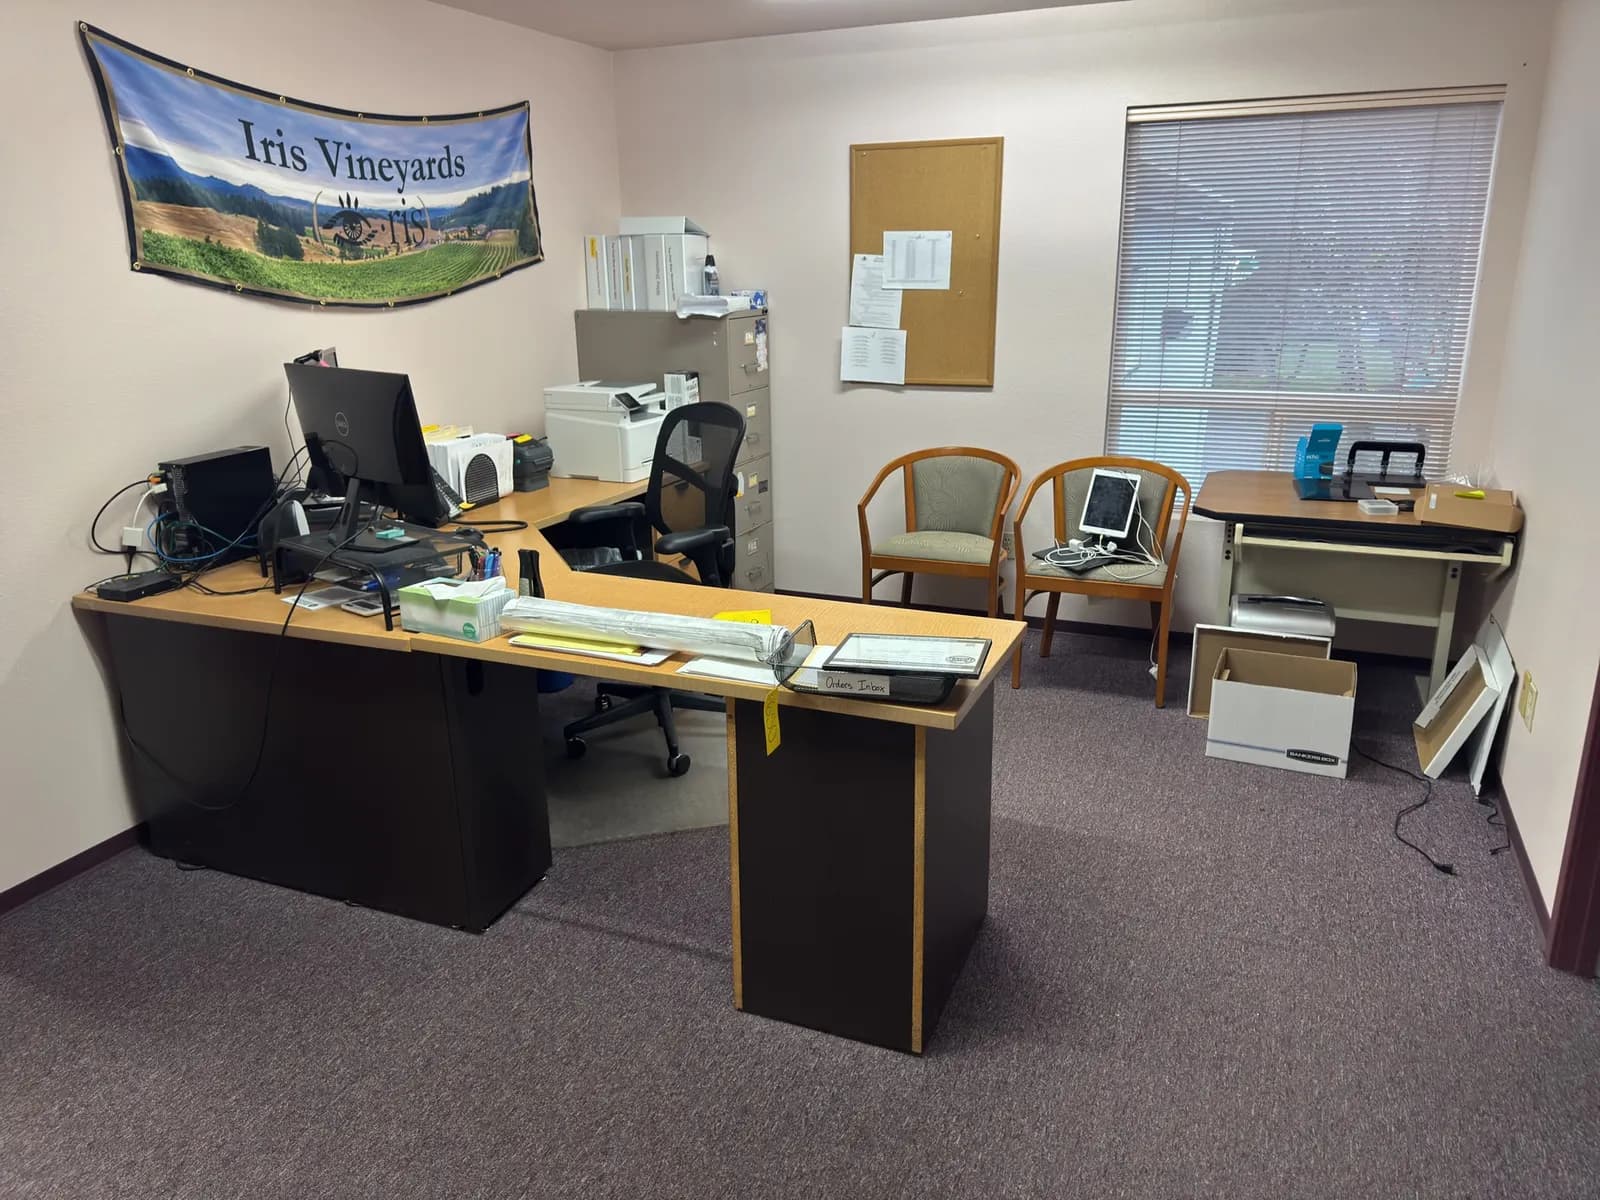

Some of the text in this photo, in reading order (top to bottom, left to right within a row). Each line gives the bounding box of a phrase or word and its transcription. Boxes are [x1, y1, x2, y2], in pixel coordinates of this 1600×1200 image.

[238, 118, 465, 194] Iris Vineyards
[825, 676, 885, 693] Orders Inbox
